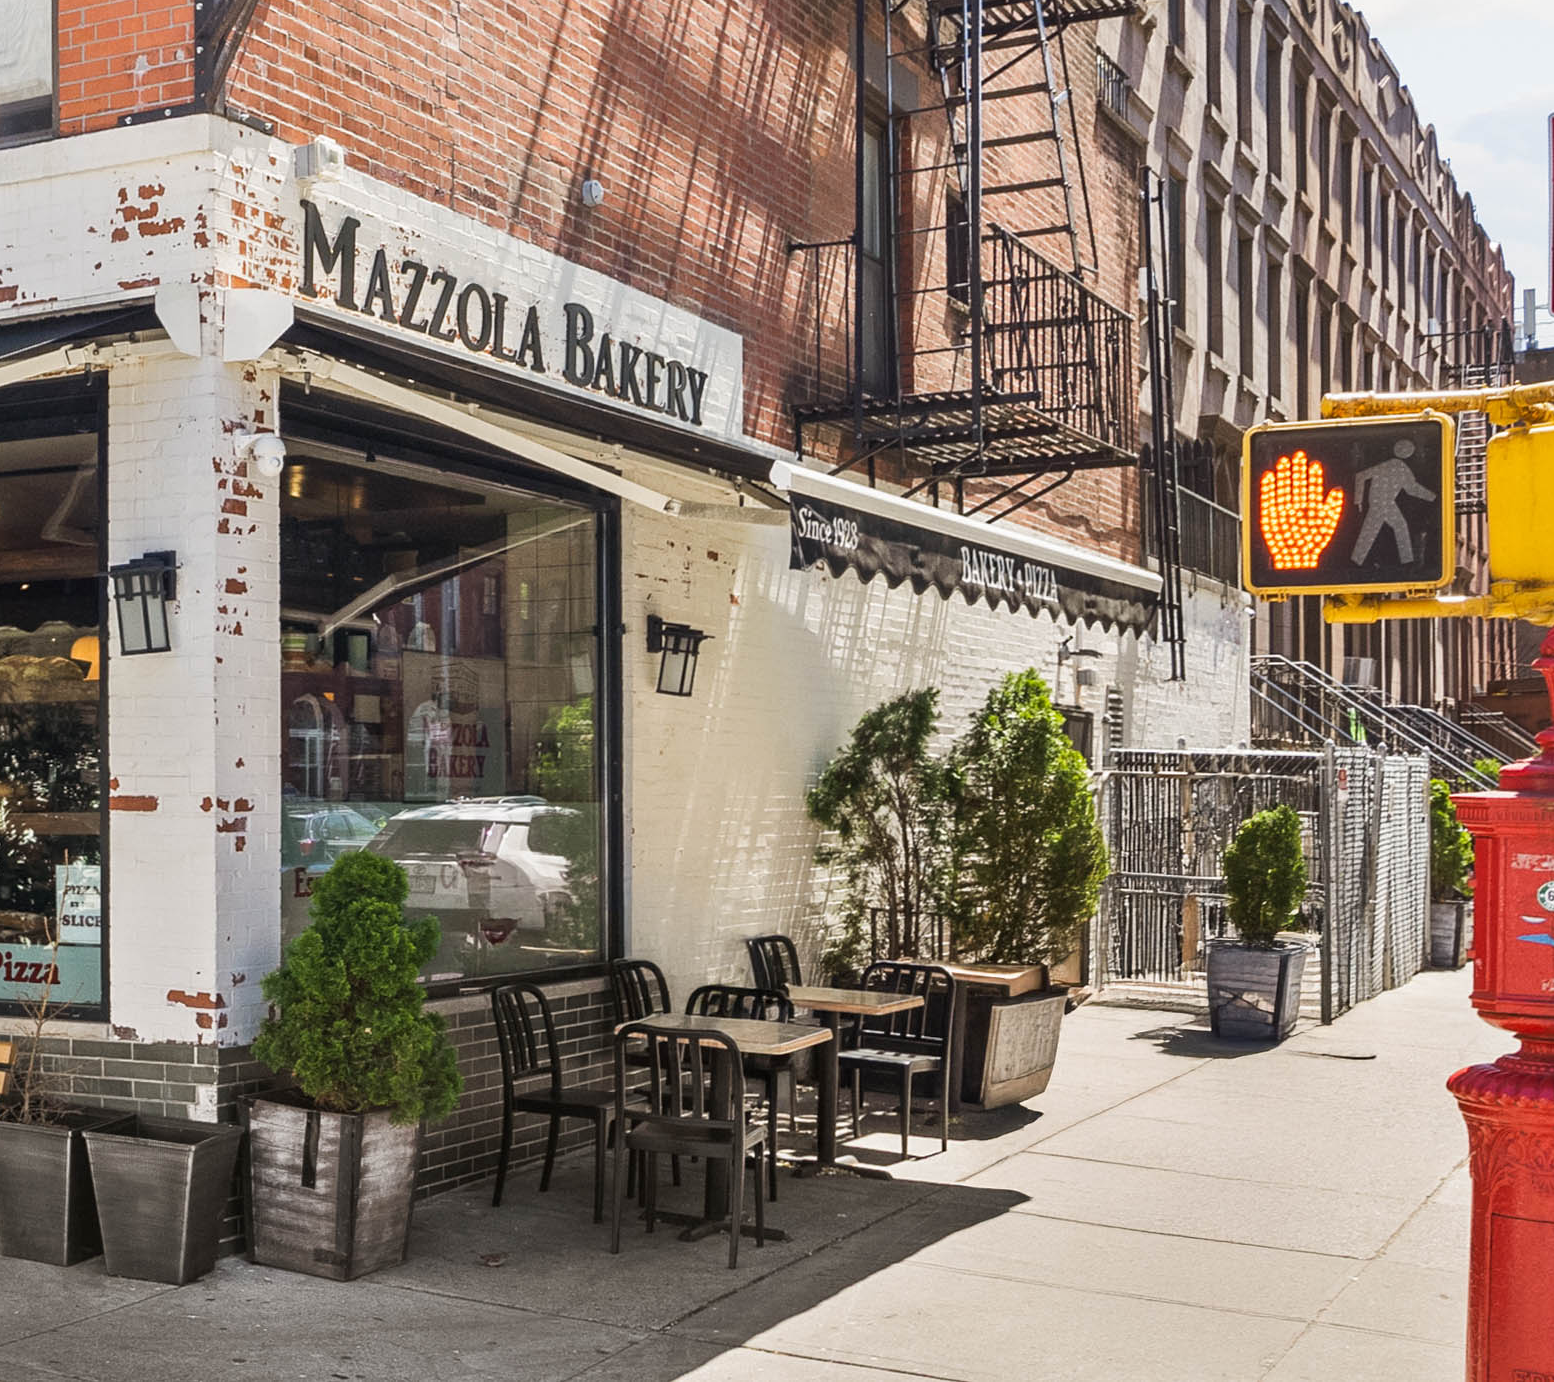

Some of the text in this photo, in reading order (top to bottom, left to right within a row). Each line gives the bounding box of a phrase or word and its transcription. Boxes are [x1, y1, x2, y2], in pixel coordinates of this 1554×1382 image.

[299, 199, 709, 426] MAZZOLA BAKERY
[798, 507, 859, 551] Since 1928
[960, 546, 1060, 603] BAKERY PIZZA
